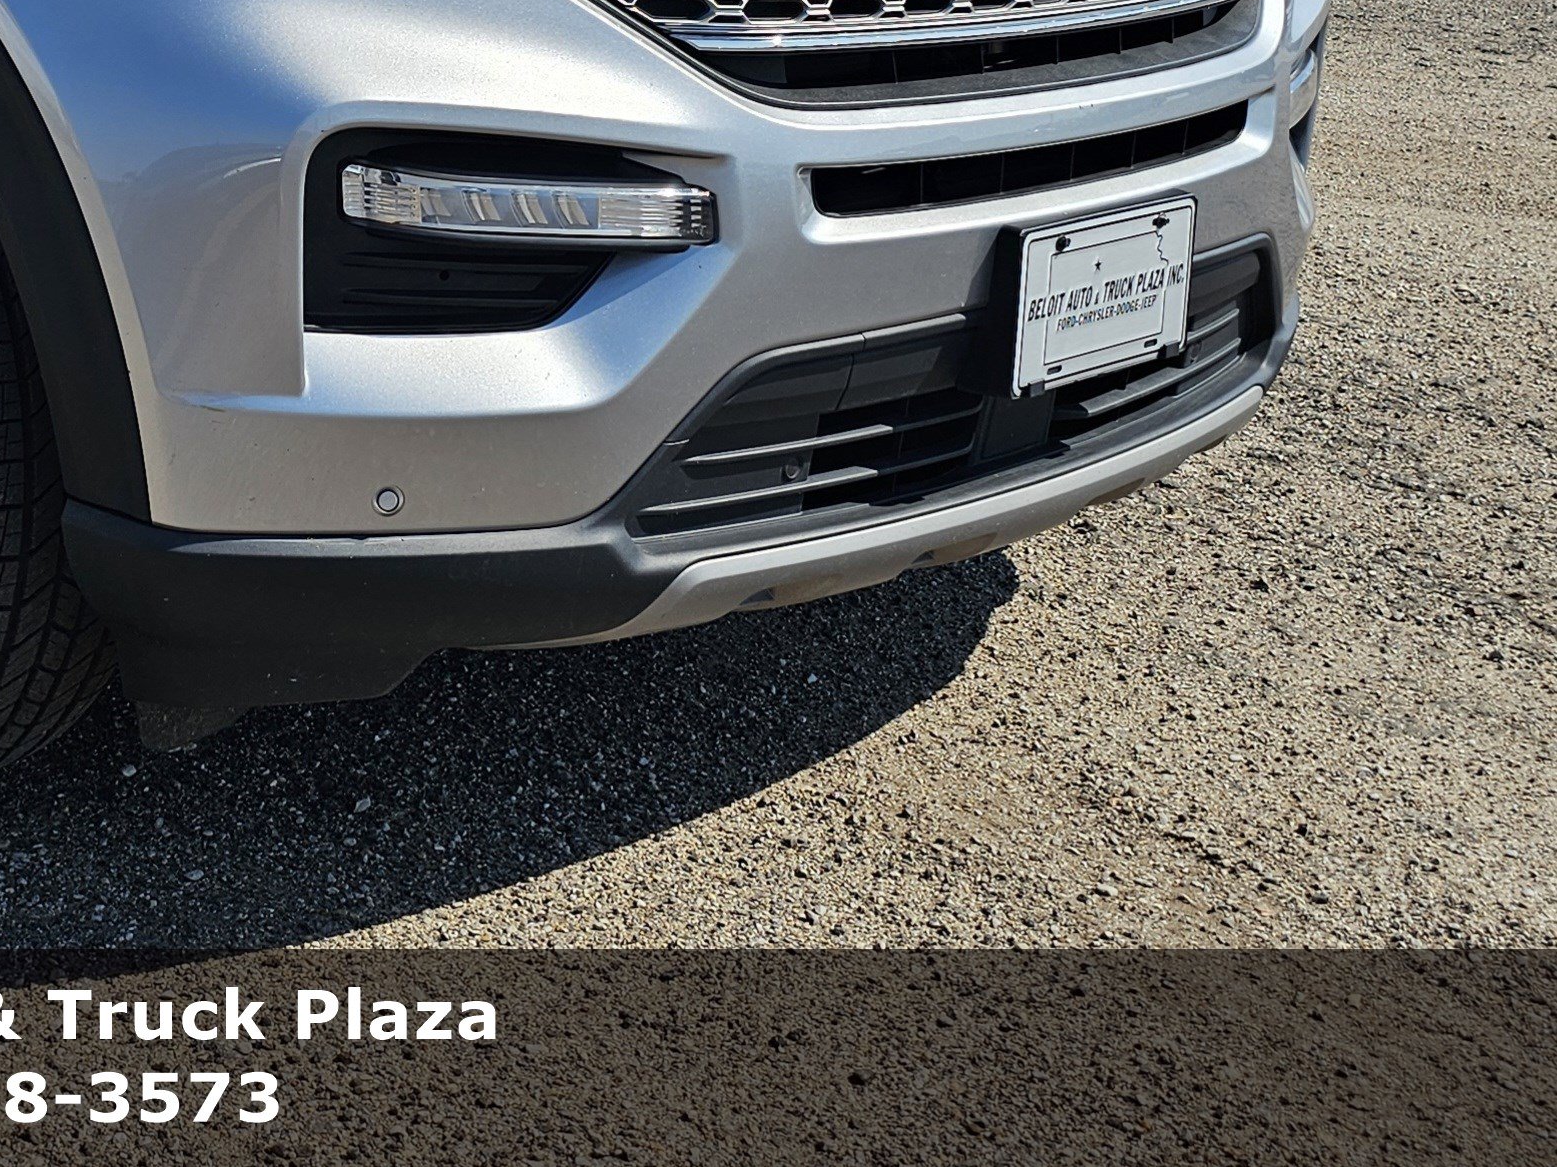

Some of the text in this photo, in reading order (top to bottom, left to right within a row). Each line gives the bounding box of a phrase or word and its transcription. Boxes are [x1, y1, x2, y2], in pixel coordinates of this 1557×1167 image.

[1027, 292, 1066, 322] BELOIT
[1066, 285, 1093, 312] AUTO
[1103, 275, 1135, 303] TRUCK
[1135, 268, 1165, 295] PLAZA
